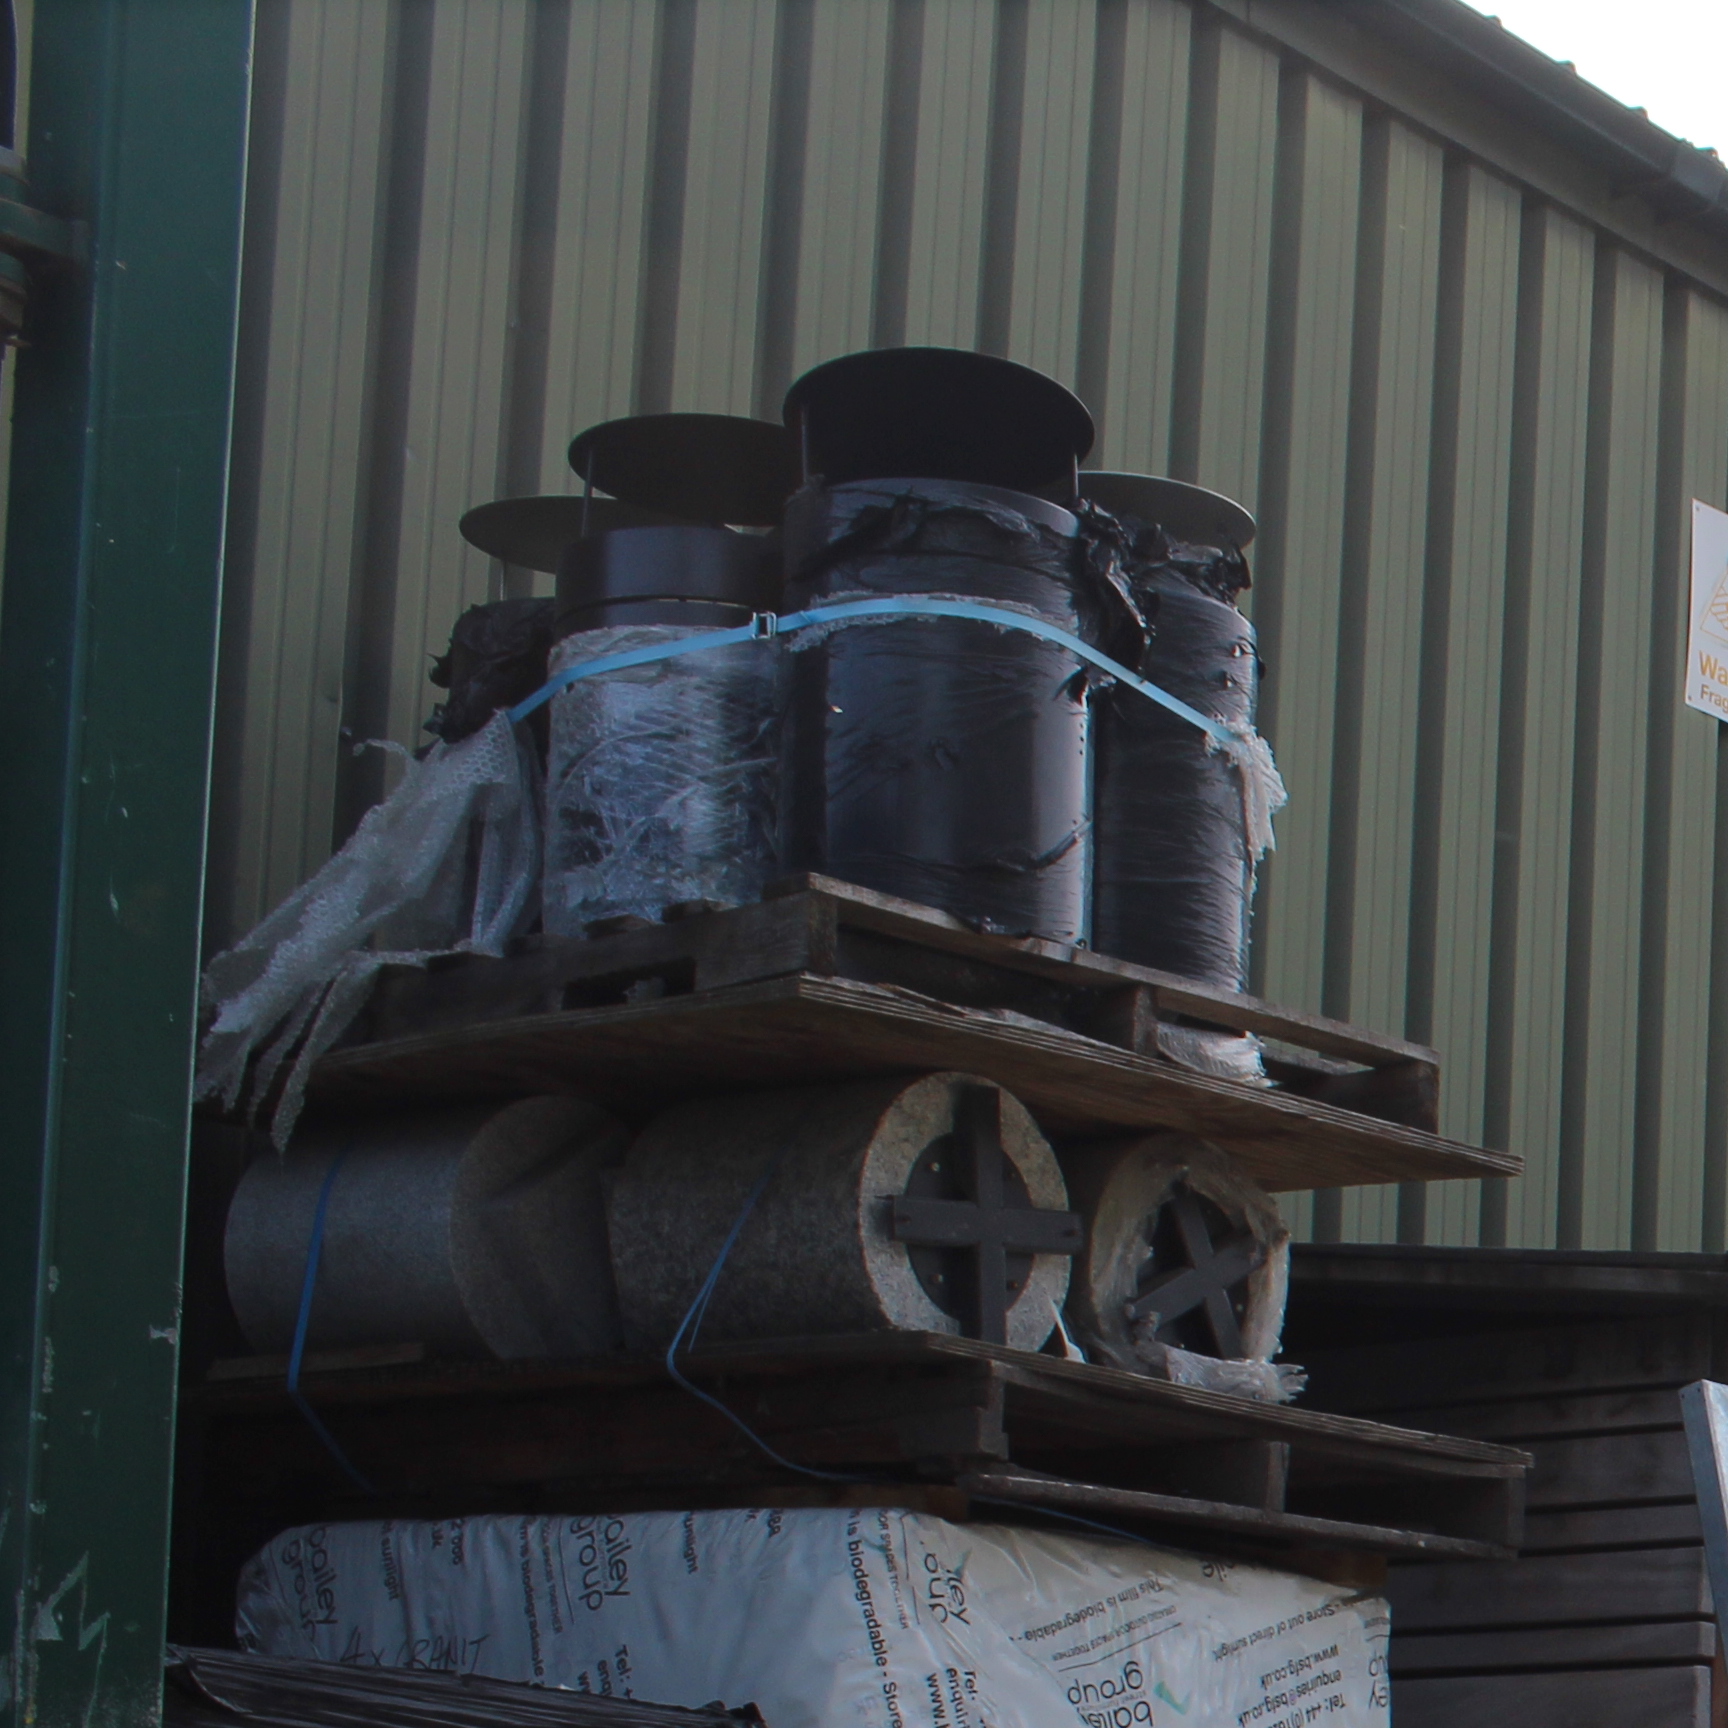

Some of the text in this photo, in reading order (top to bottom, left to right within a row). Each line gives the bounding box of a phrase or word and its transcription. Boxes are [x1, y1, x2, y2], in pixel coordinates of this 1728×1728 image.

[603, 1514, 633, 1598] ailey
[848, 1540, 888, 1668] biodegradable
[1024, 1602, 1106, 1642] biodegradable
[1287, 1614, 1305, 1630] out
[1306, 1603, 1336, 1624] Store
[1249, 1625, 1276, 1646] direct
[614, 1644, 633, 1684] Tel:
[1067, 1660, 1145, 1706] group
[1259, 1643, 1340, 1692] www.bsfg.co.uk
[1324, 1692, 1347, 1710] Tel:
